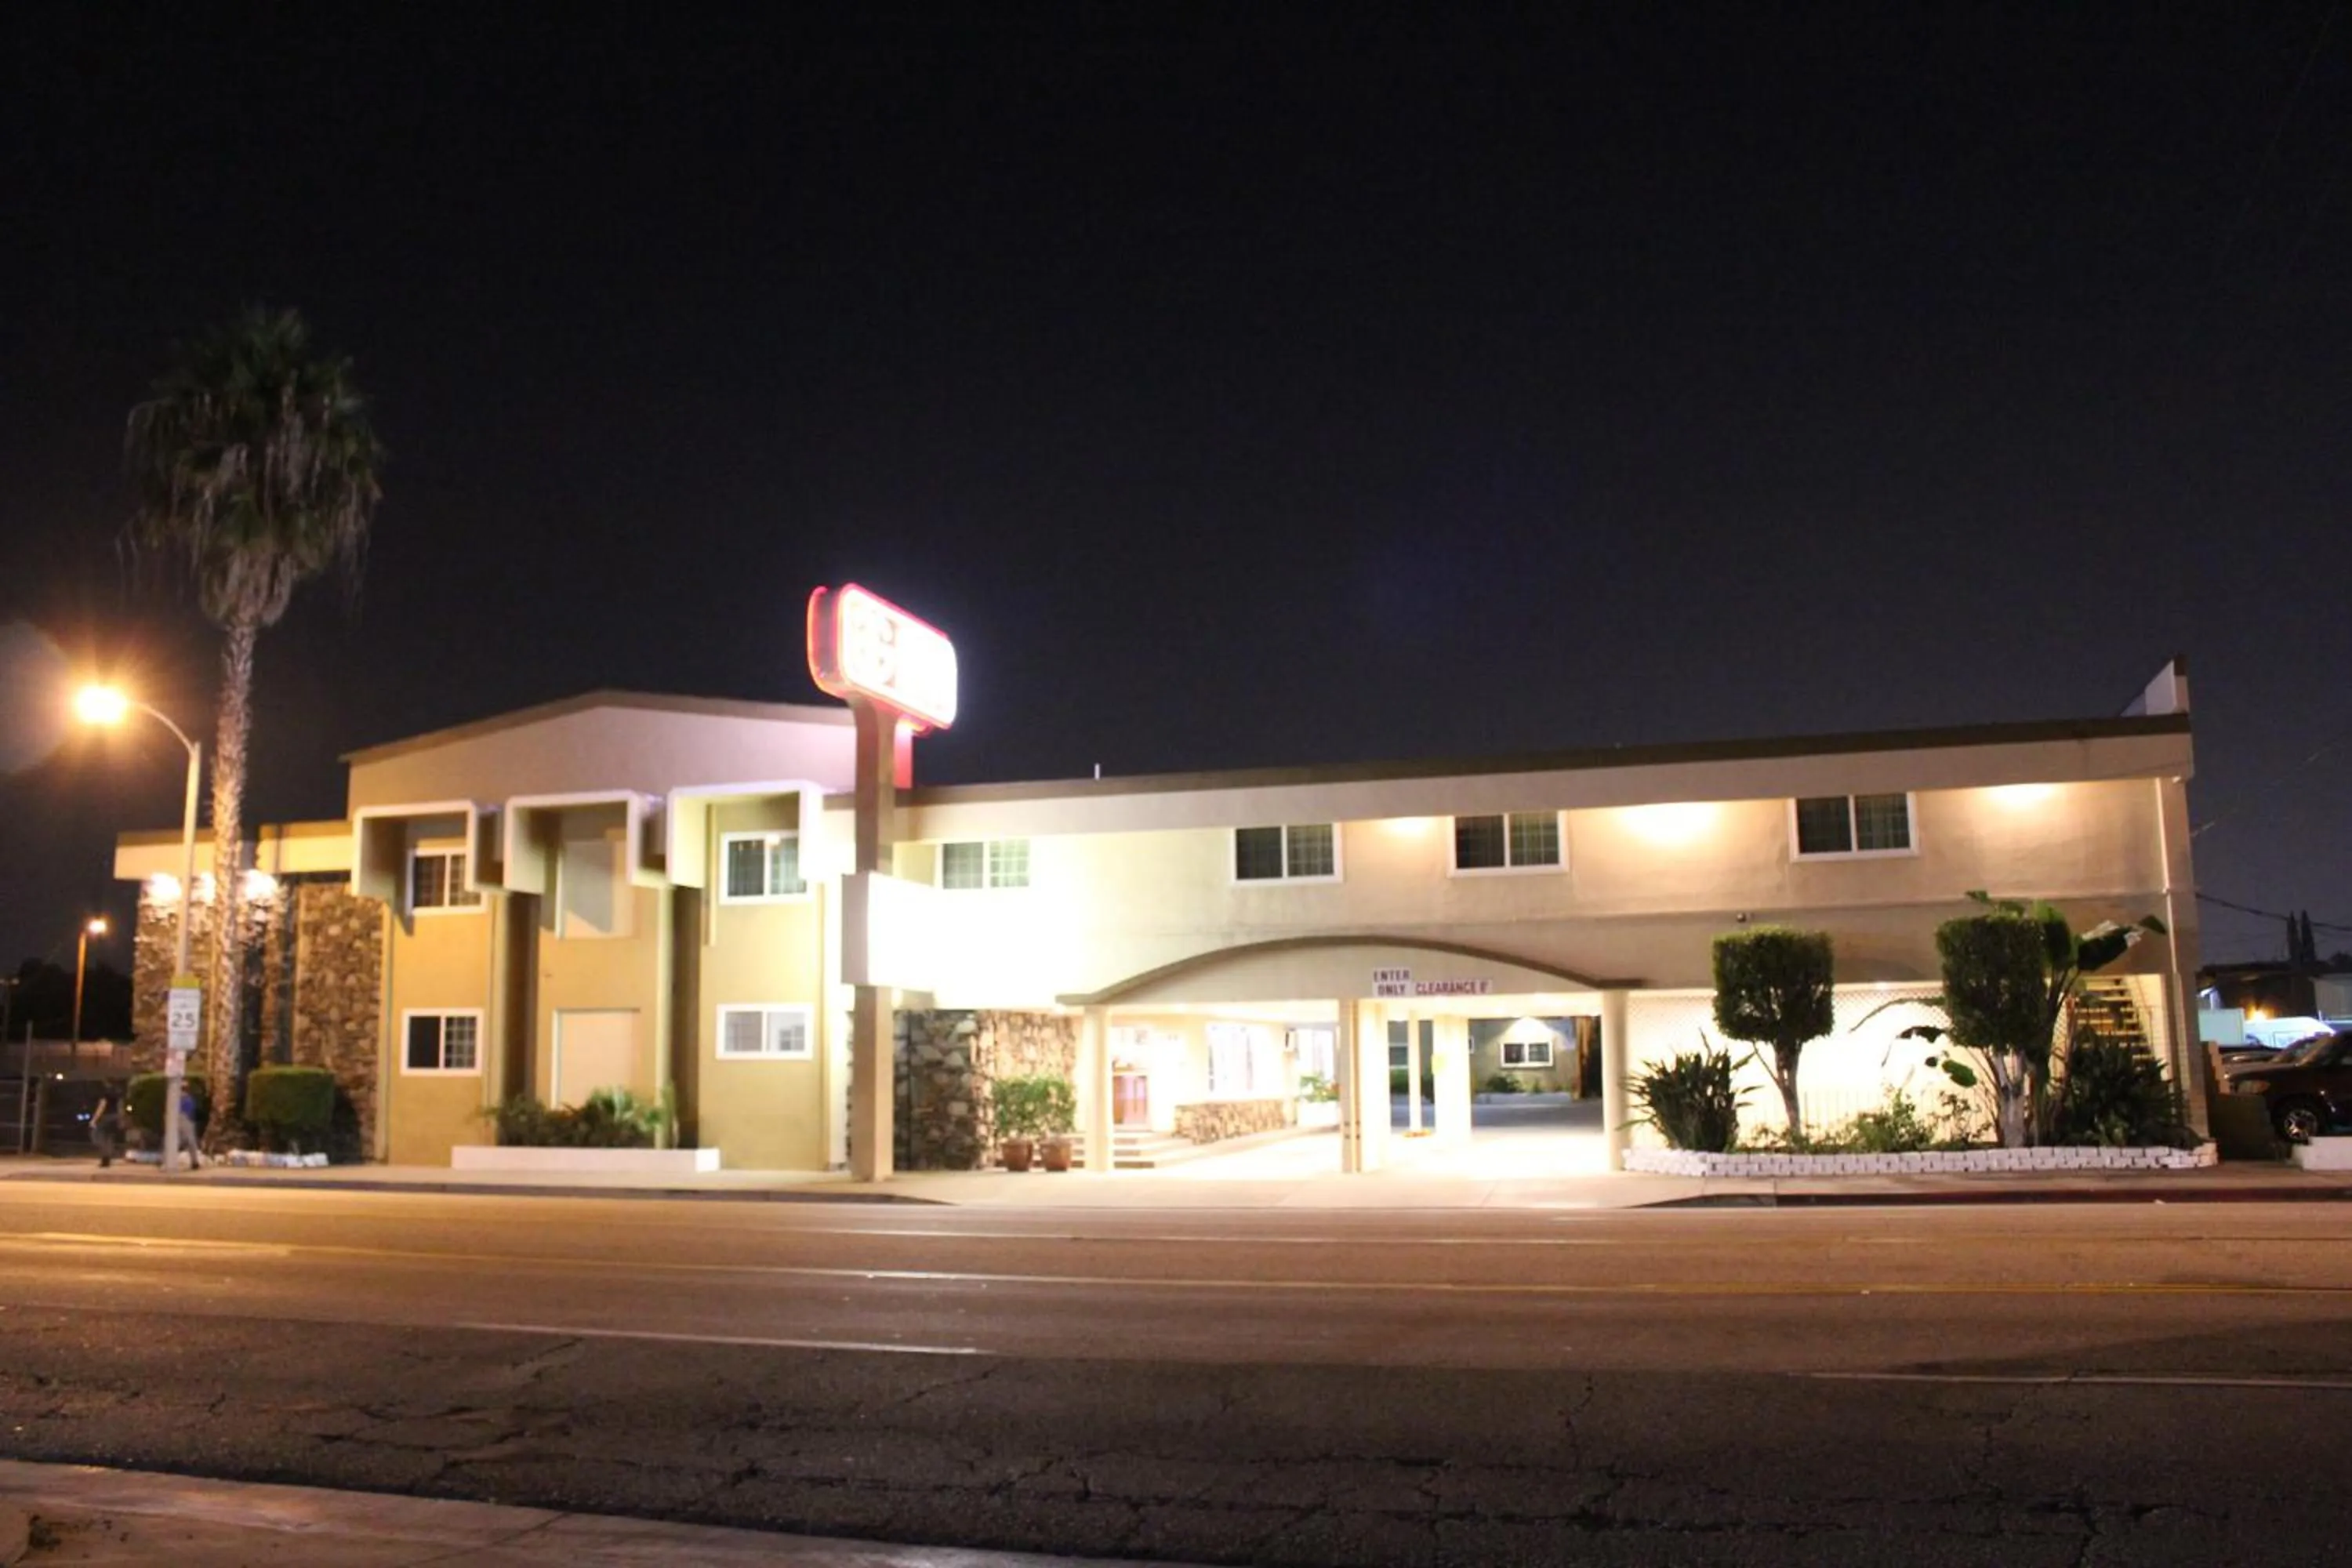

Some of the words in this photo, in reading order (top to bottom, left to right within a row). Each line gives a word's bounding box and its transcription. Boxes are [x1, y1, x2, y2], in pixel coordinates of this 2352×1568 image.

[1374, 970, 1410, 982] ENTER
[1377, 983, 1406, 996] ONLY
[1415, 981, 1475, 996] CLEARANCE
[172, 1011, 196, 1029] 25
